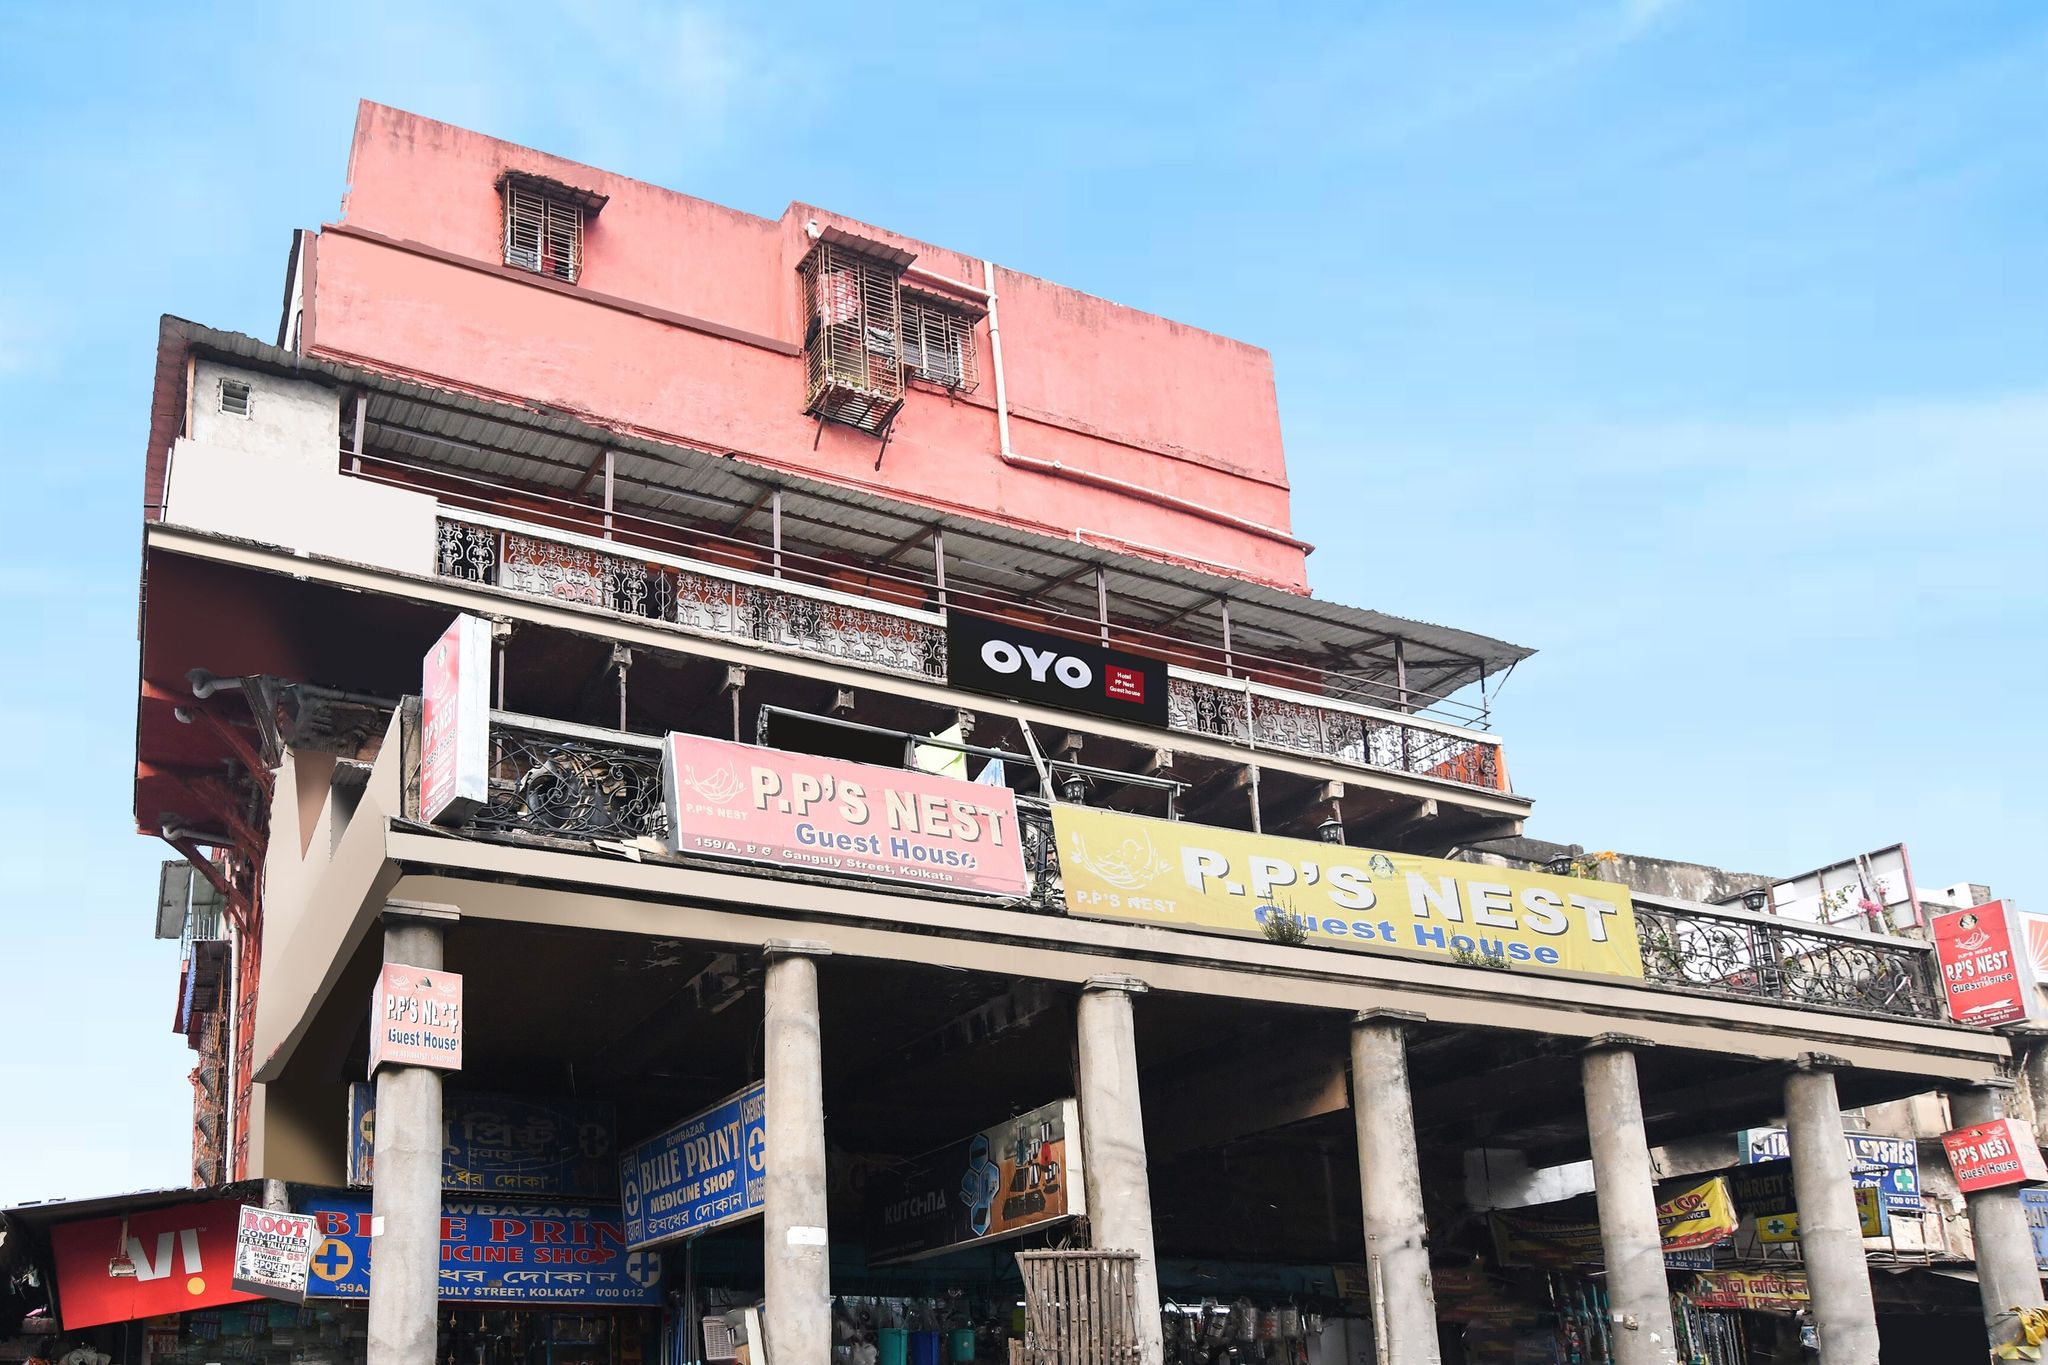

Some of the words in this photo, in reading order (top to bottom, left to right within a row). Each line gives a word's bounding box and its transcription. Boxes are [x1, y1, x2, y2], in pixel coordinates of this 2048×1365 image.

[981, 639, 1092, 689] OYO
[1117, 672, 1132, 680] Hotel
[1123, 681, 1135, 689] Nest
[686, 803, 714, 816] P.P'S
[717, 808, 749, 821] NEST
[750, 766, 871, 826] P.P'S
[884, 788, 1008, 848] NEST
[796, 823, 881, 855] Guest
[890, 836, 977, 870] House
[694, 837, 743, 854] 159/A,
[782, 850, 842, 869] Ganguly
[846, 858, 896, 875] Street,
[900, 866, 953, 882] Kolkata
[1127, 896, 1177, 912] NEST
[1179, 846, 1375, 911] P.P'S
[1406, 871, 1617, 943] NEST
[1413, 924, 1561, 965] House
[1976, 950, 2009, 974] NEST
[388, 1028, 420, 1046] Guest
[424, 1031, 457, 1051] House
[666, 1122, 706, 1148] BOWBAZAR
[641, 1149, 681, 1195] BLUE
[684, 1120, 741, 1178] PRINT
[1960, 1169, 1988, 1180] Guest
[1988, 1160, 2018, 1173] House
[651, 1183, 700, 1214] MEDICINE
[703, 1170, 735, 1196] SHOP
[1905, 1197, 1918, 1205] 012
[695, 1191, 743, 1221] দোকান
[244, 1212, 309, 1238] ROOT
[242, 1229, 307, 1246] COMPUTER
[254, 1260, 290, 1273] SPOKEN
[286, 1252, 306, 1262] GST
[265, 1279, 292, 1288] AMHERST
[474, 1287, 526, 1298] STREET,
[622, 1289, 645, 1298] 012
